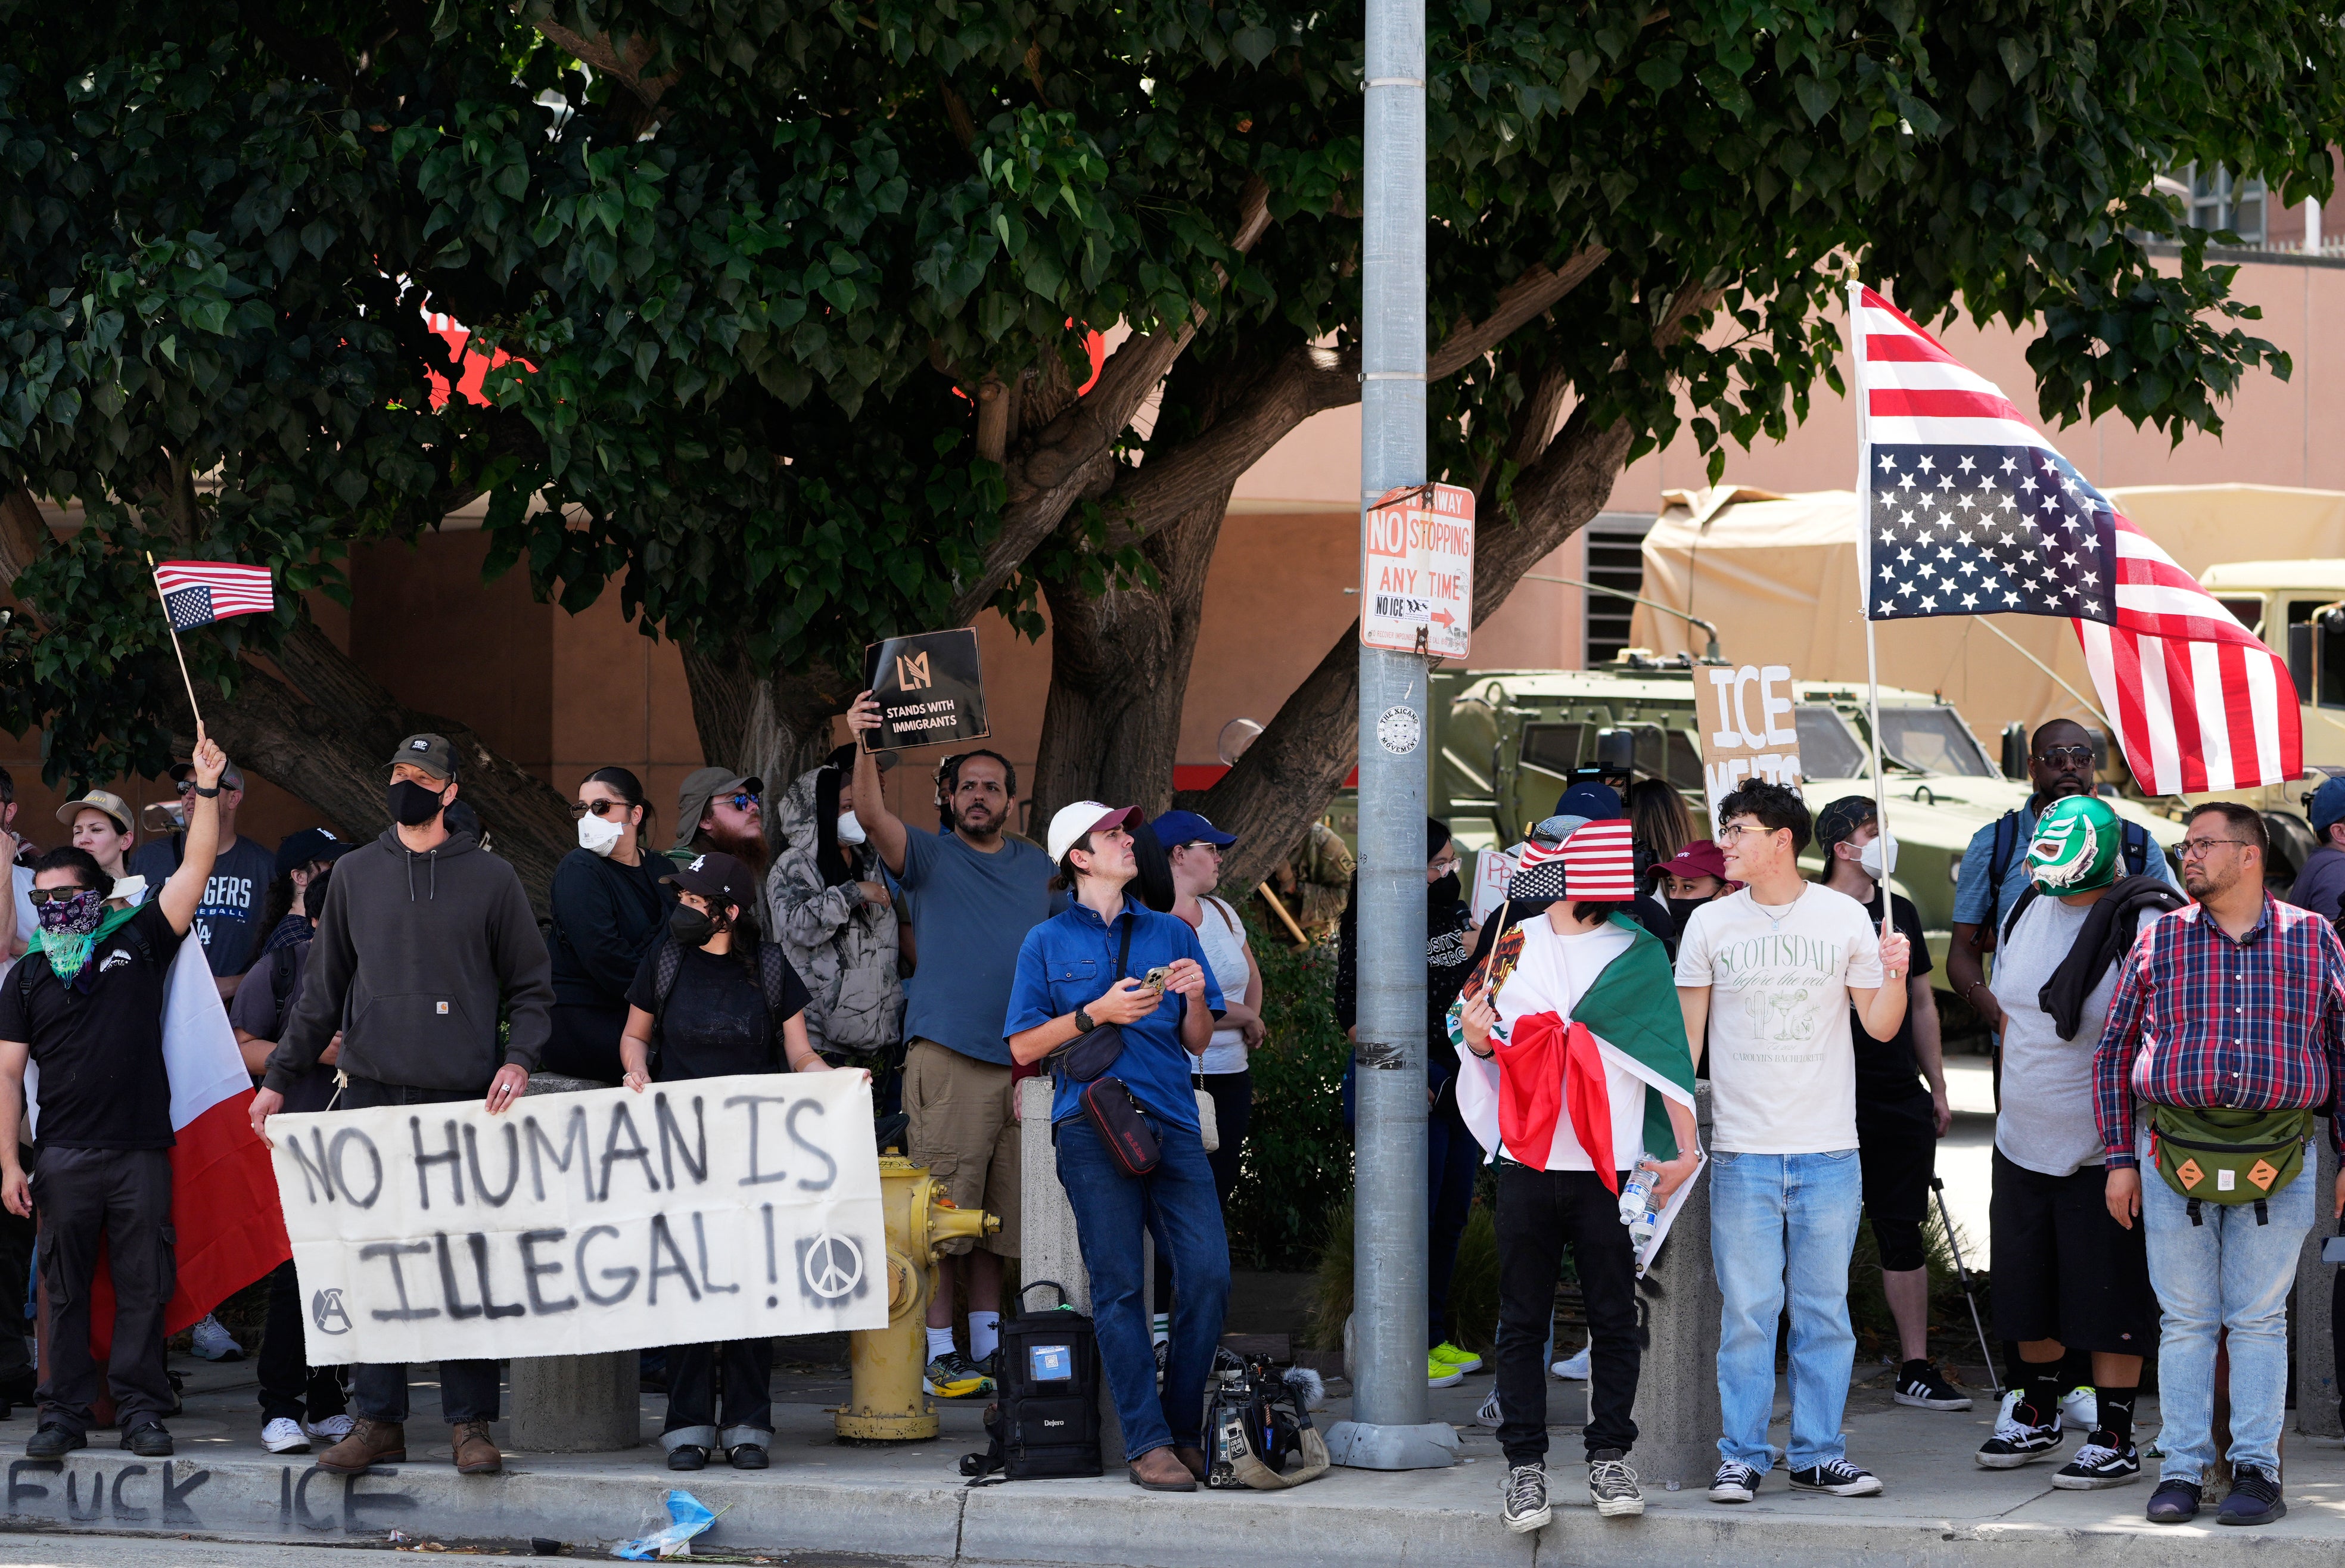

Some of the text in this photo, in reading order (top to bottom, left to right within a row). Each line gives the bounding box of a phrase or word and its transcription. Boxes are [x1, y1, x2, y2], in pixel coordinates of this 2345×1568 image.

[1370, 511, 1469, 556] NO STOPPING
[1379, 566, 1460, 601] ANY TIME
[1376, 596, 1388, 615] NO
[1390, 599, 1404, 617] ICE
[887, 699, 954, 718] STANDS WITH
[1380, 711, 1393, 723] THE
[1709, 664, 1797, 749] ICE
[892, 715, 957, 733] IMMIGRANTS
[1382, 738, 1417, 752] MOVEMENT
[688, 854, 706, 872] LA
[164, 876, 252, 909] GERS
[195, 909, 244, 917] EBALL
[1721, 934, 1842, 978] SCOTTSDALE
[1728, 969, 1831, 994] before the veil
[1733, 1053, 1825, 1063] CAROLYN'S BACHELORETTE
[287, 1093, 836, 1209] NO HUMAN IS
[7, 1460, 418, 1533] FUCK ICE
